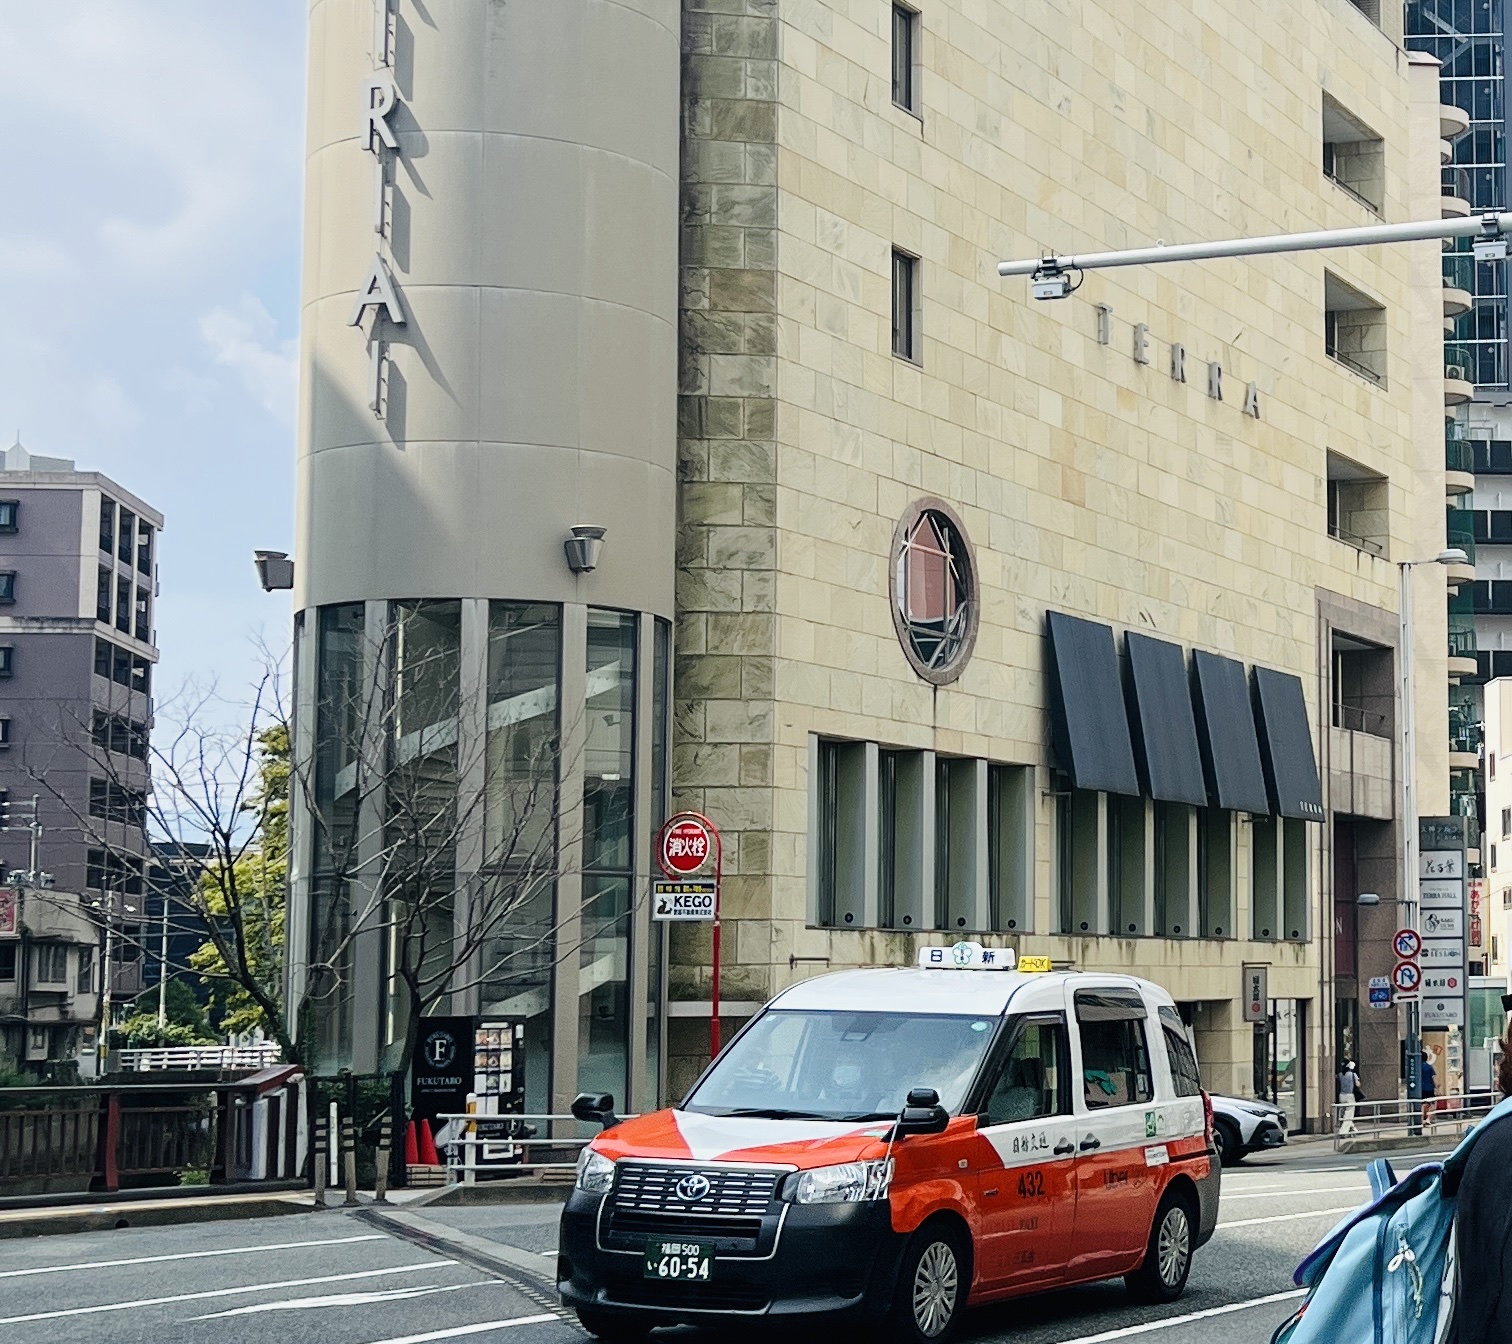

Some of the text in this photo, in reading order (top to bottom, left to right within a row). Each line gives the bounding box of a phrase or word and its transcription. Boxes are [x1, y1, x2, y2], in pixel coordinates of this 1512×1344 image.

[1097, 302, 1260, 419] TERRA
[668, 837, 705, 856] 消火栓
[674, 895, 712, 908] KEGO
[416, 1076, 462, 1086] FUKUTARO
[1017, 1170, 1046, 1199] 432
[658, 1255, 709, 1280] 60-54
